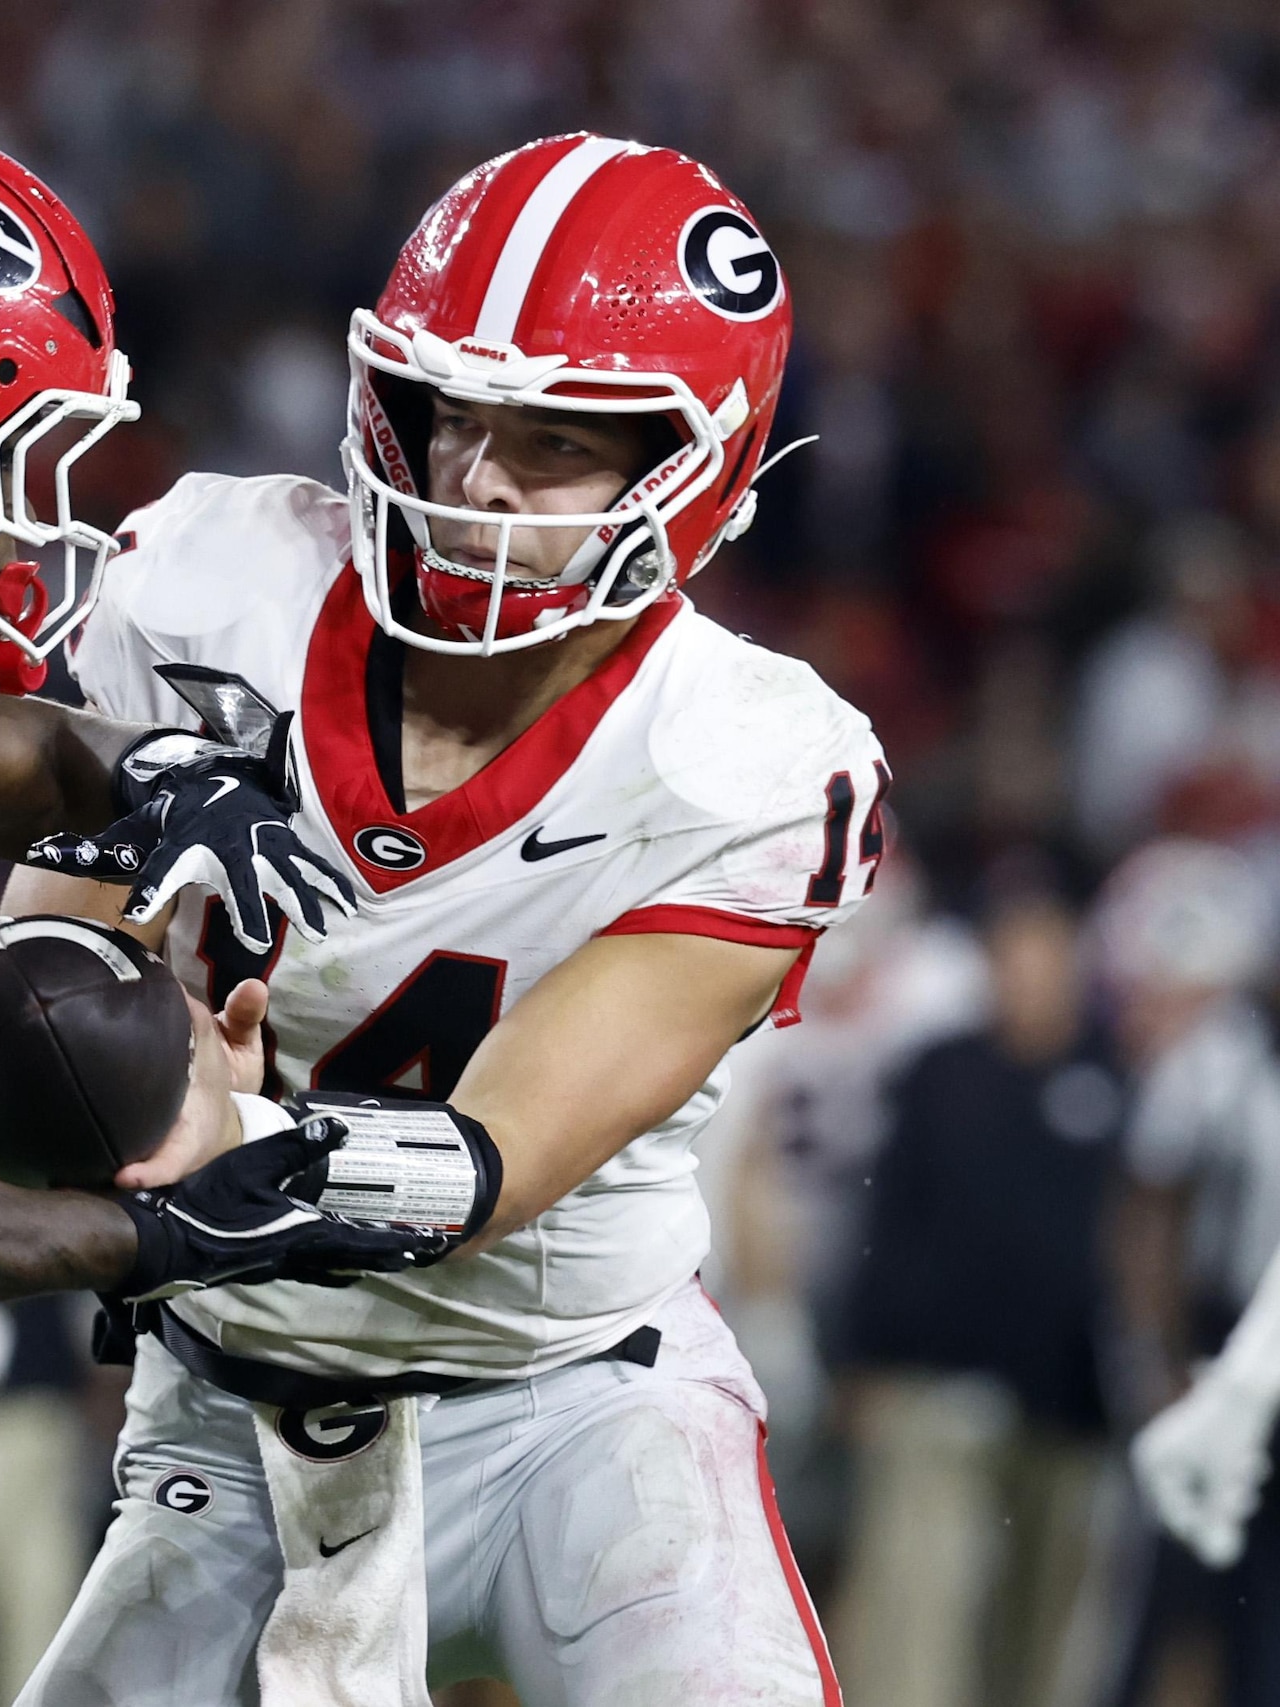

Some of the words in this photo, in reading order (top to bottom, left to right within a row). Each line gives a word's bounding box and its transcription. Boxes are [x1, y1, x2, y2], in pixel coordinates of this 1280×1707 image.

[677, 205, 788, 322] G
[460, 343, 508, 362] DAWGS
[353, 826, 426, 871] G
[153, 1468, 213, 1516] G
